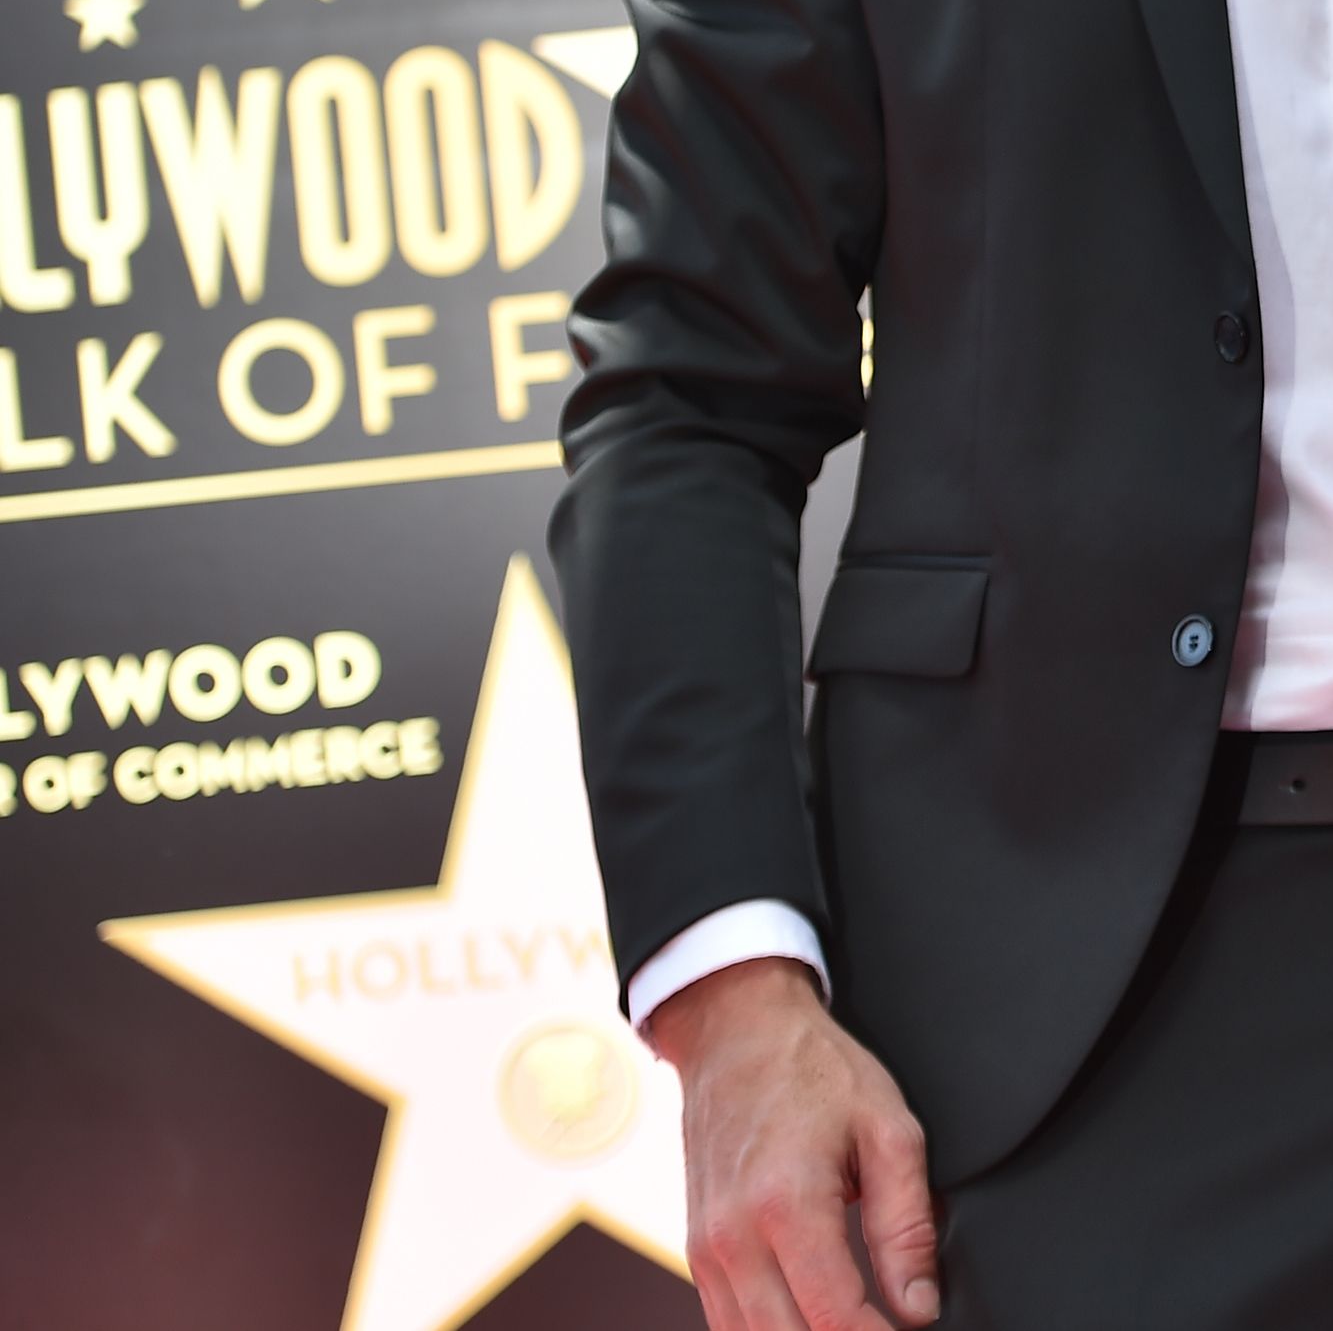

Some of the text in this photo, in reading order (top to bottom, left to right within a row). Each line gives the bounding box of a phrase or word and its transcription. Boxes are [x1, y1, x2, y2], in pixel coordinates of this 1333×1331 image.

[218, 303, 437, 447] OF
[23, 751, 108, 814] OF
[113, 716, 443, 806] COMMERCE
